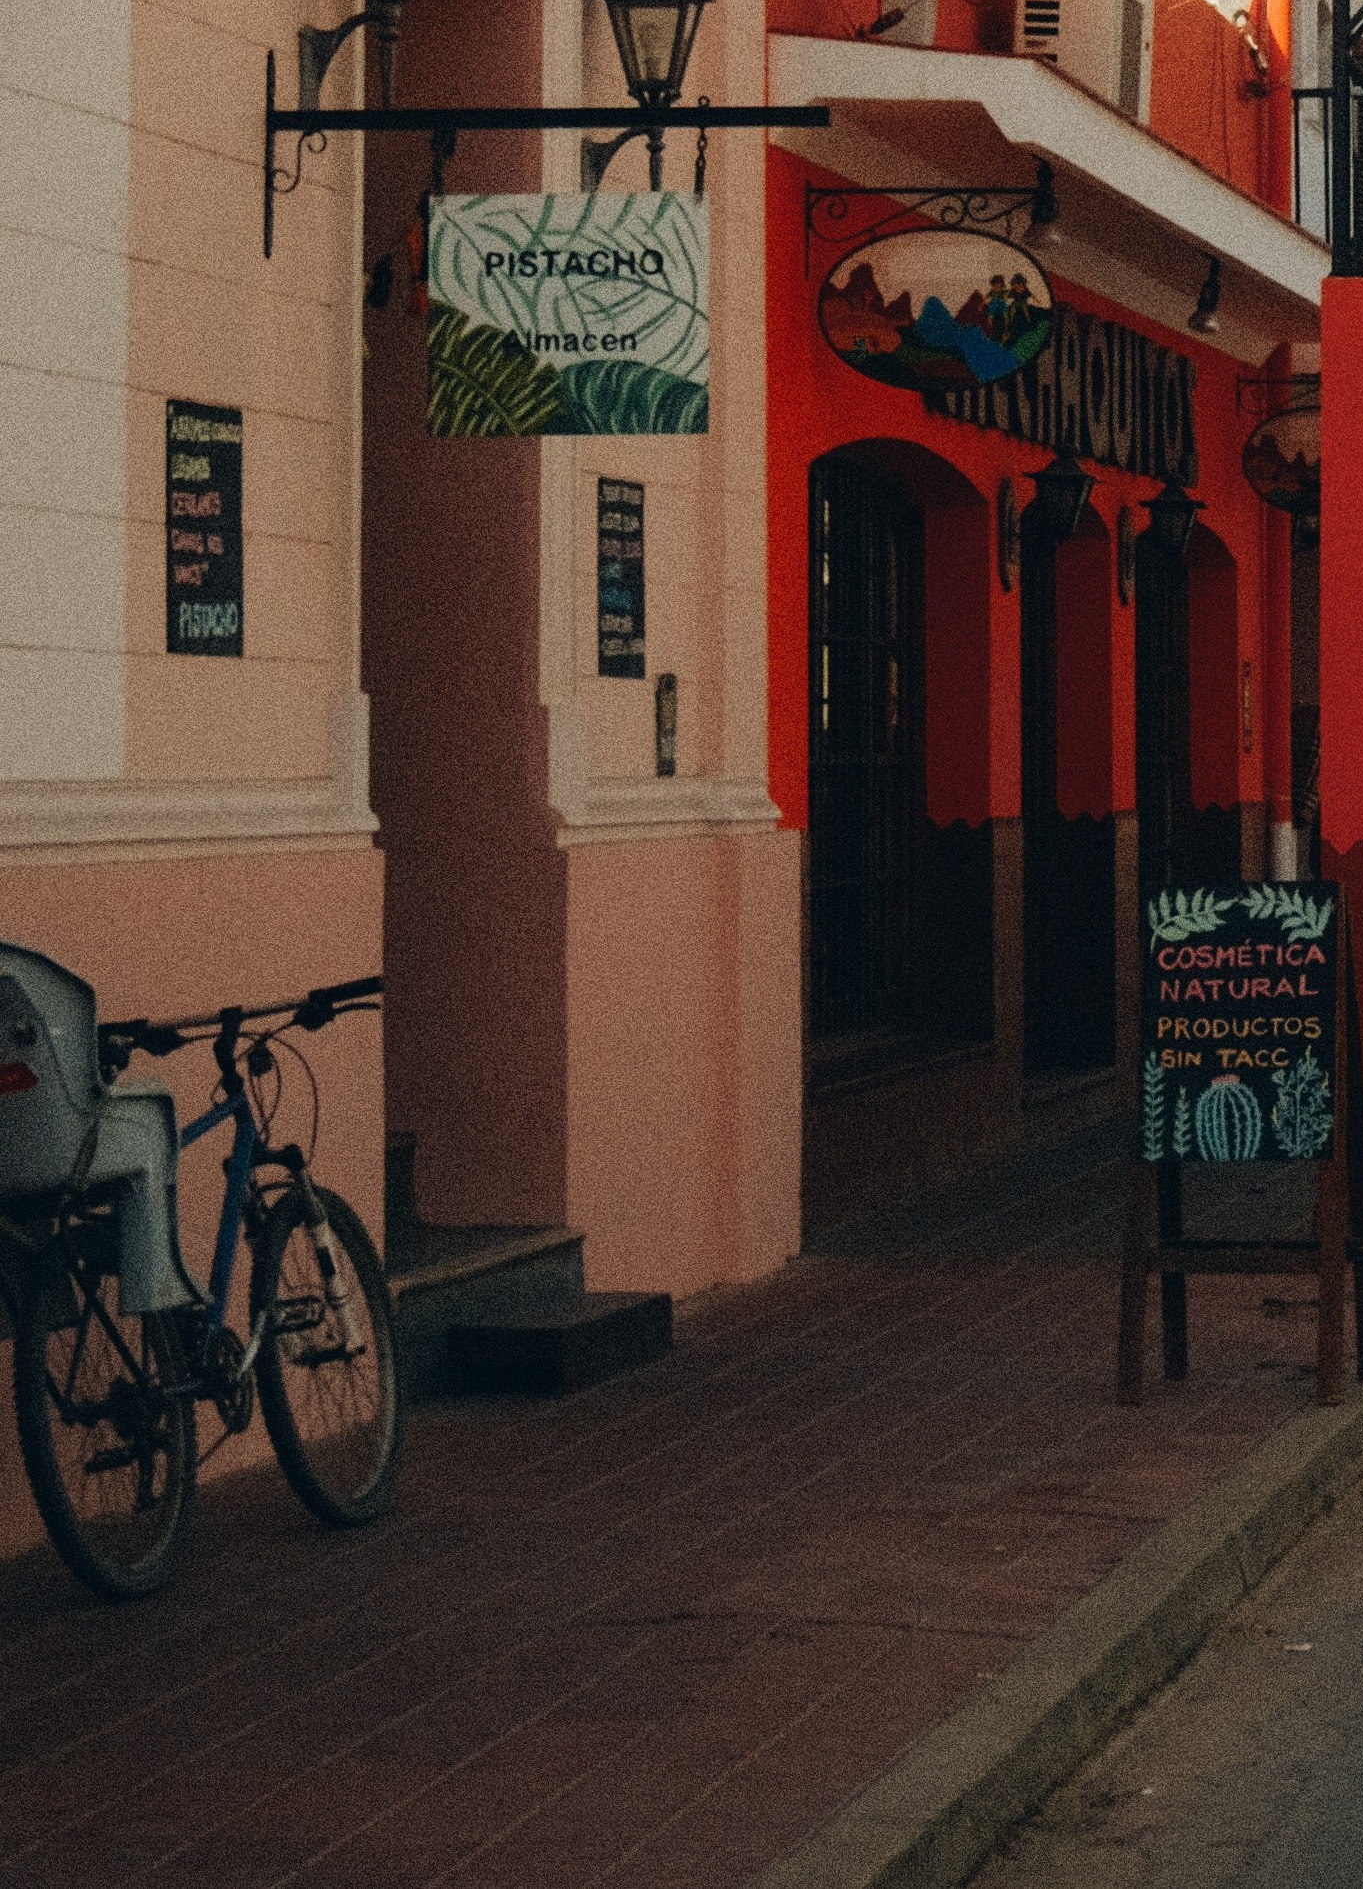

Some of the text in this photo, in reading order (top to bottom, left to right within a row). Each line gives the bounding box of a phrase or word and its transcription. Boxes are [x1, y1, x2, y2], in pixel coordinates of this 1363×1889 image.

[484, 249, 664, 277] PISTACHO
[503, 329, 638, 353] Almacen
[1157, 938, 1328, 972] COSMÉTICA
[1159, 973, 1320, 1004] NATURAL
[1156, 1015, 1323, 1042] PRODUCTOS
[1161, 1047, 1292, 1070] SIN TACC
